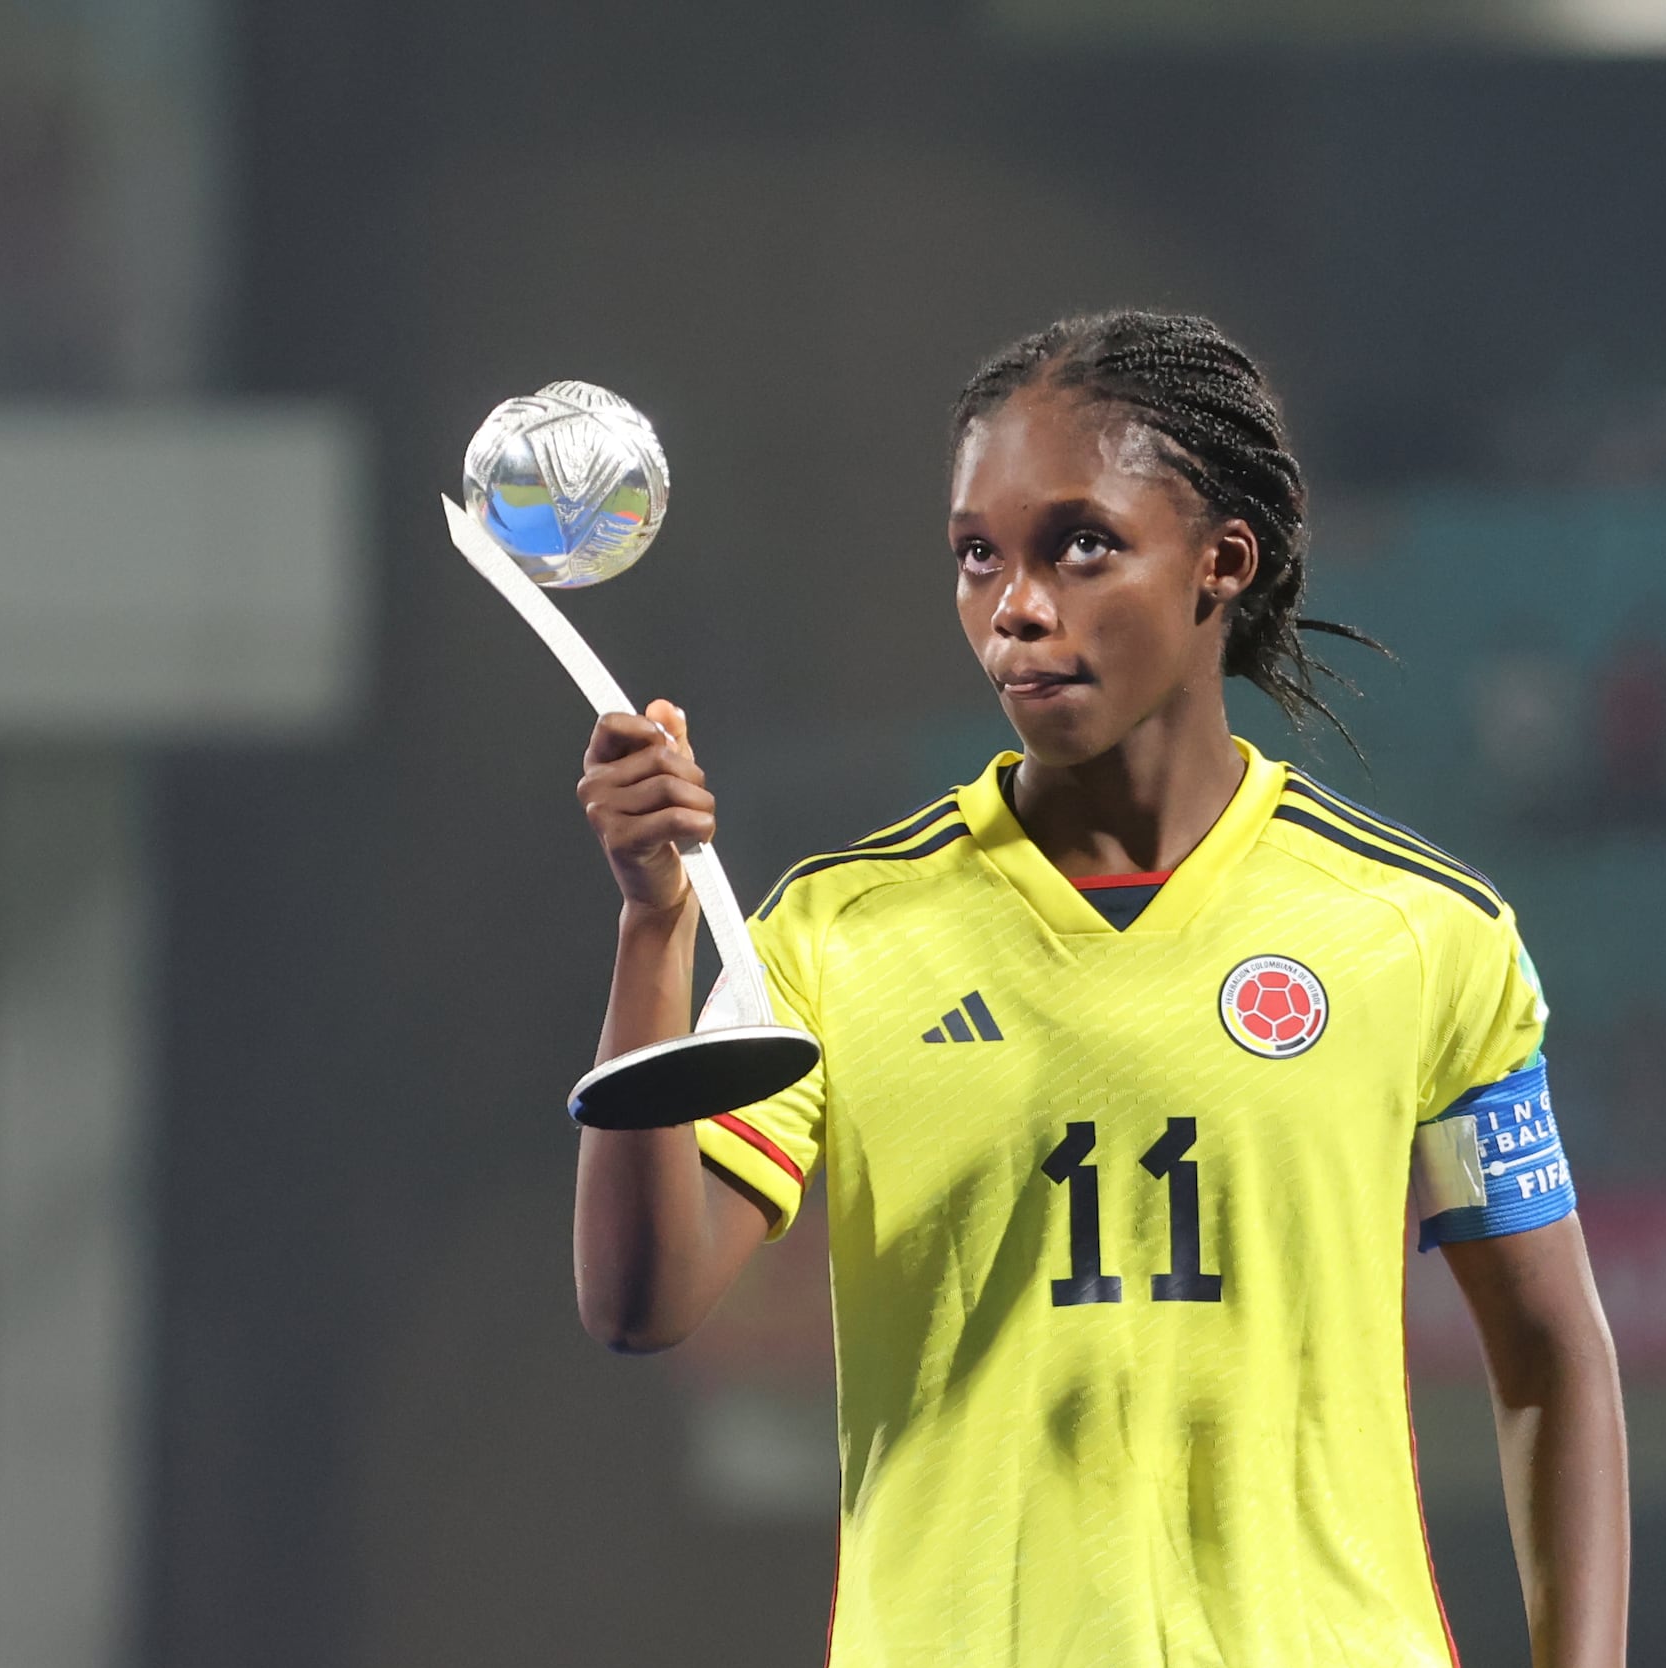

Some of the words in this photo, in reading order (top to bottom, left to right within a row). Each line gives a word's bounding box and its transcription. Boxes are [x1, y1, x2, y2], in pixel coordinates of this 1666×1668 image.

[1250, 961, 1298, 975] COLOMBIANA
[1298, 972, 1308, 981] DE
[1516, 1158, 1569, 1199] FIFA
[1041, 1117, 1222, 1307] 11
